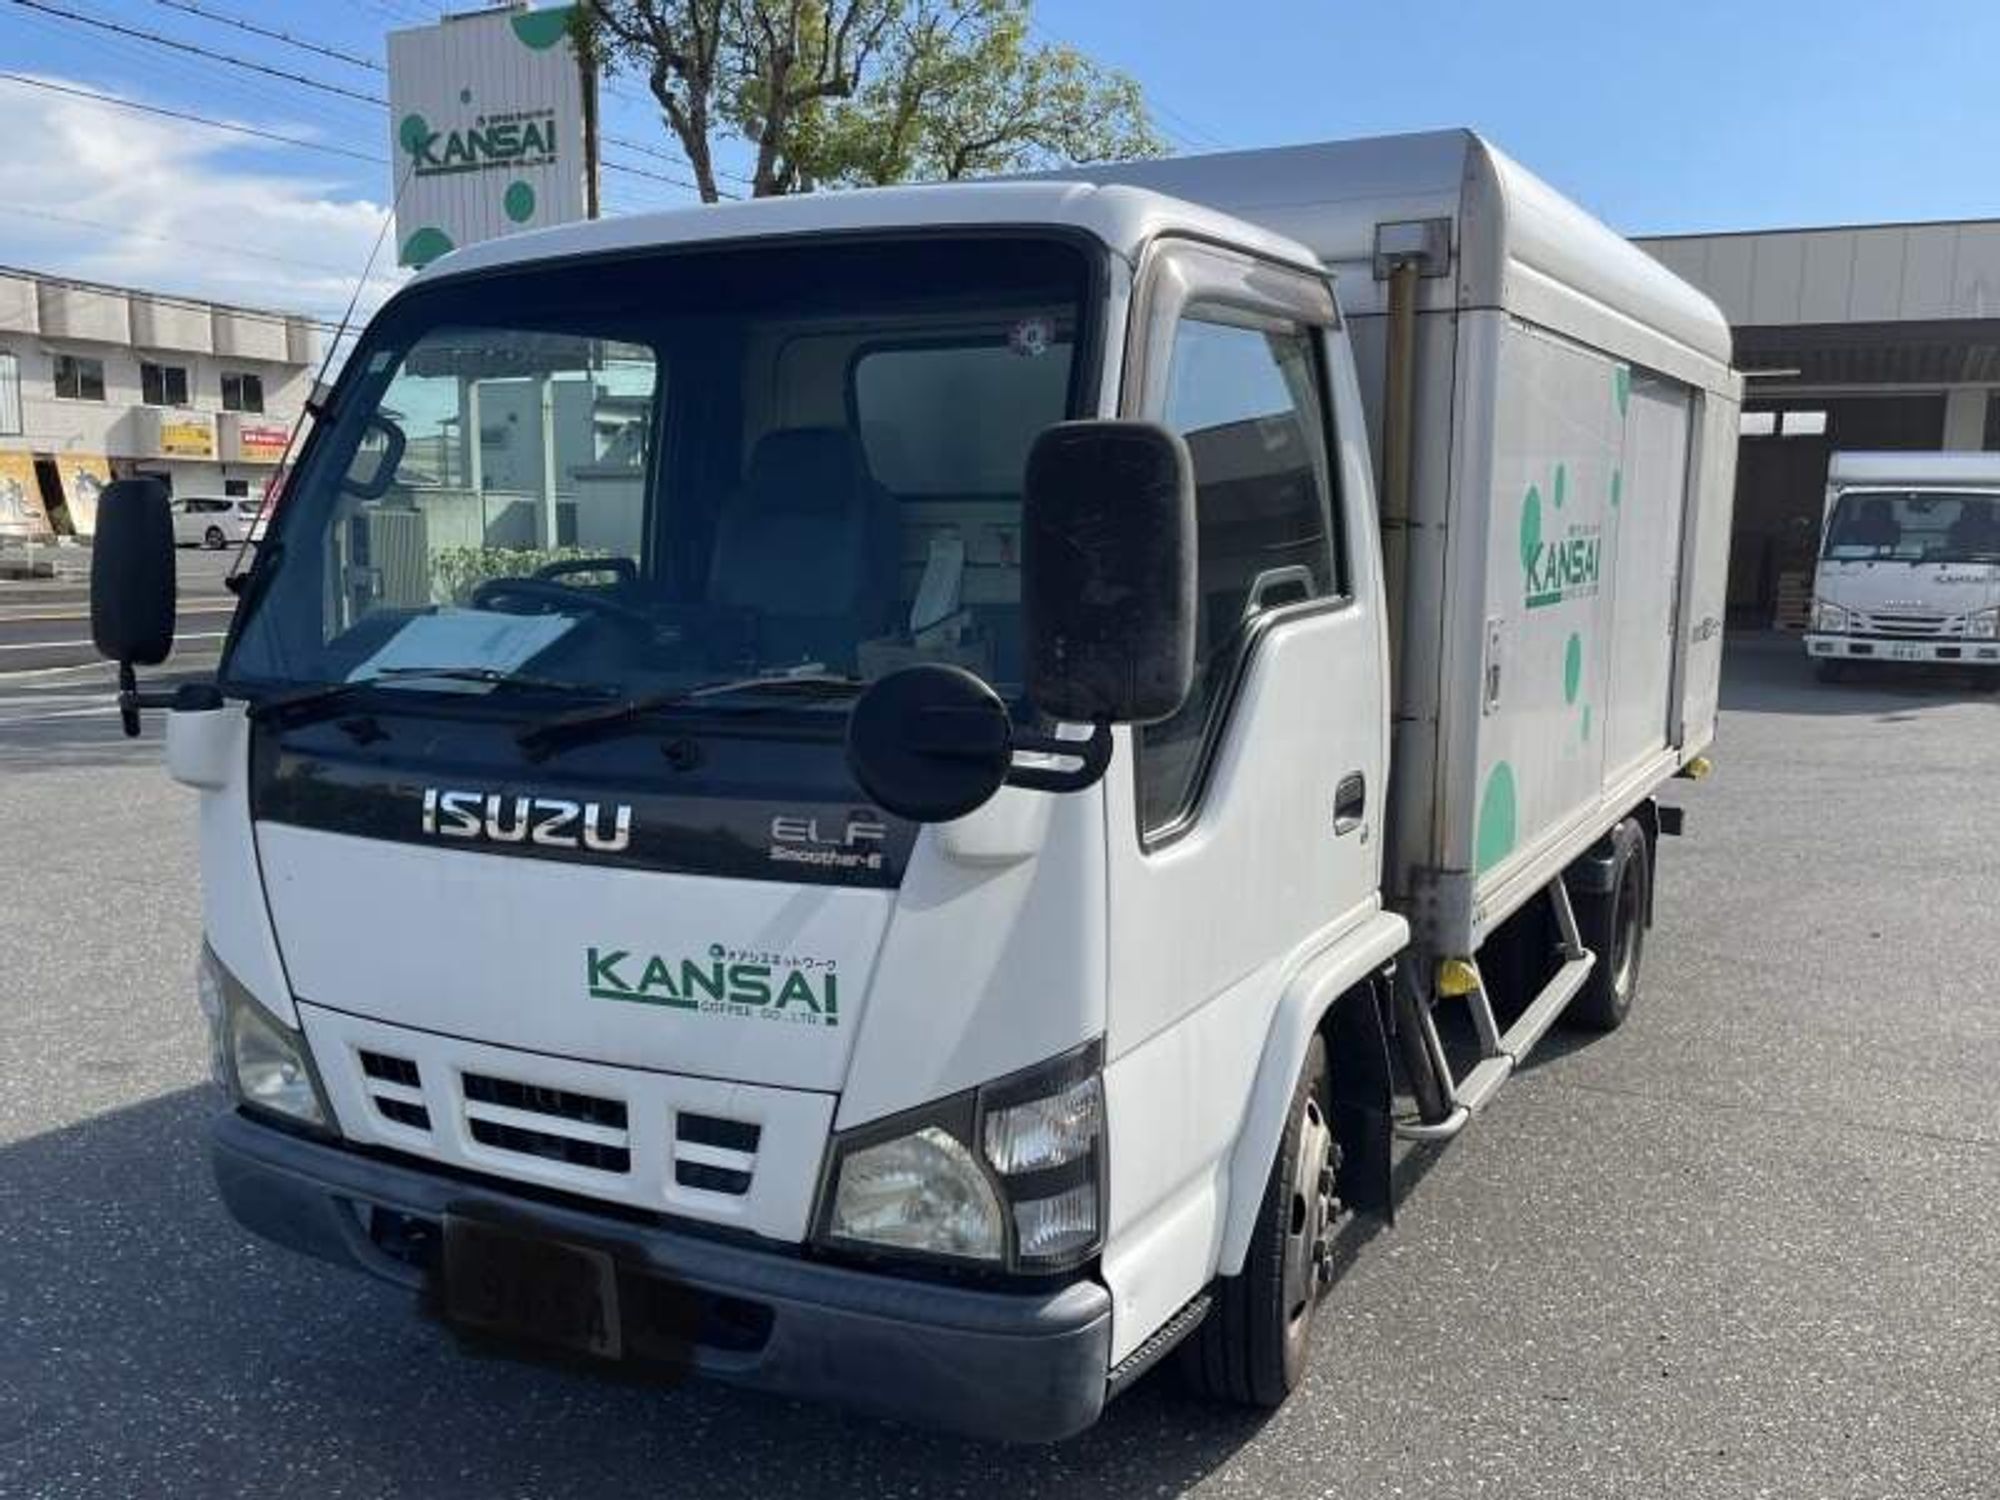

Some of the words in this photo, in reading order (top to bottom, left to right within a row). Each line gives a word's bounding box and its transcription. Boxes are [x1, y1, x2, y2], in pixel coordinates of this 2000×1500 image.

[412, 120, 556, 166] KANSAI
[1526, 537, 1600, 592] KANSAI
[422, 788, 632, 851] ISUZU
[771, 816, 887, 846] ELF
[586, 946, 839, 1022] KANSAI
